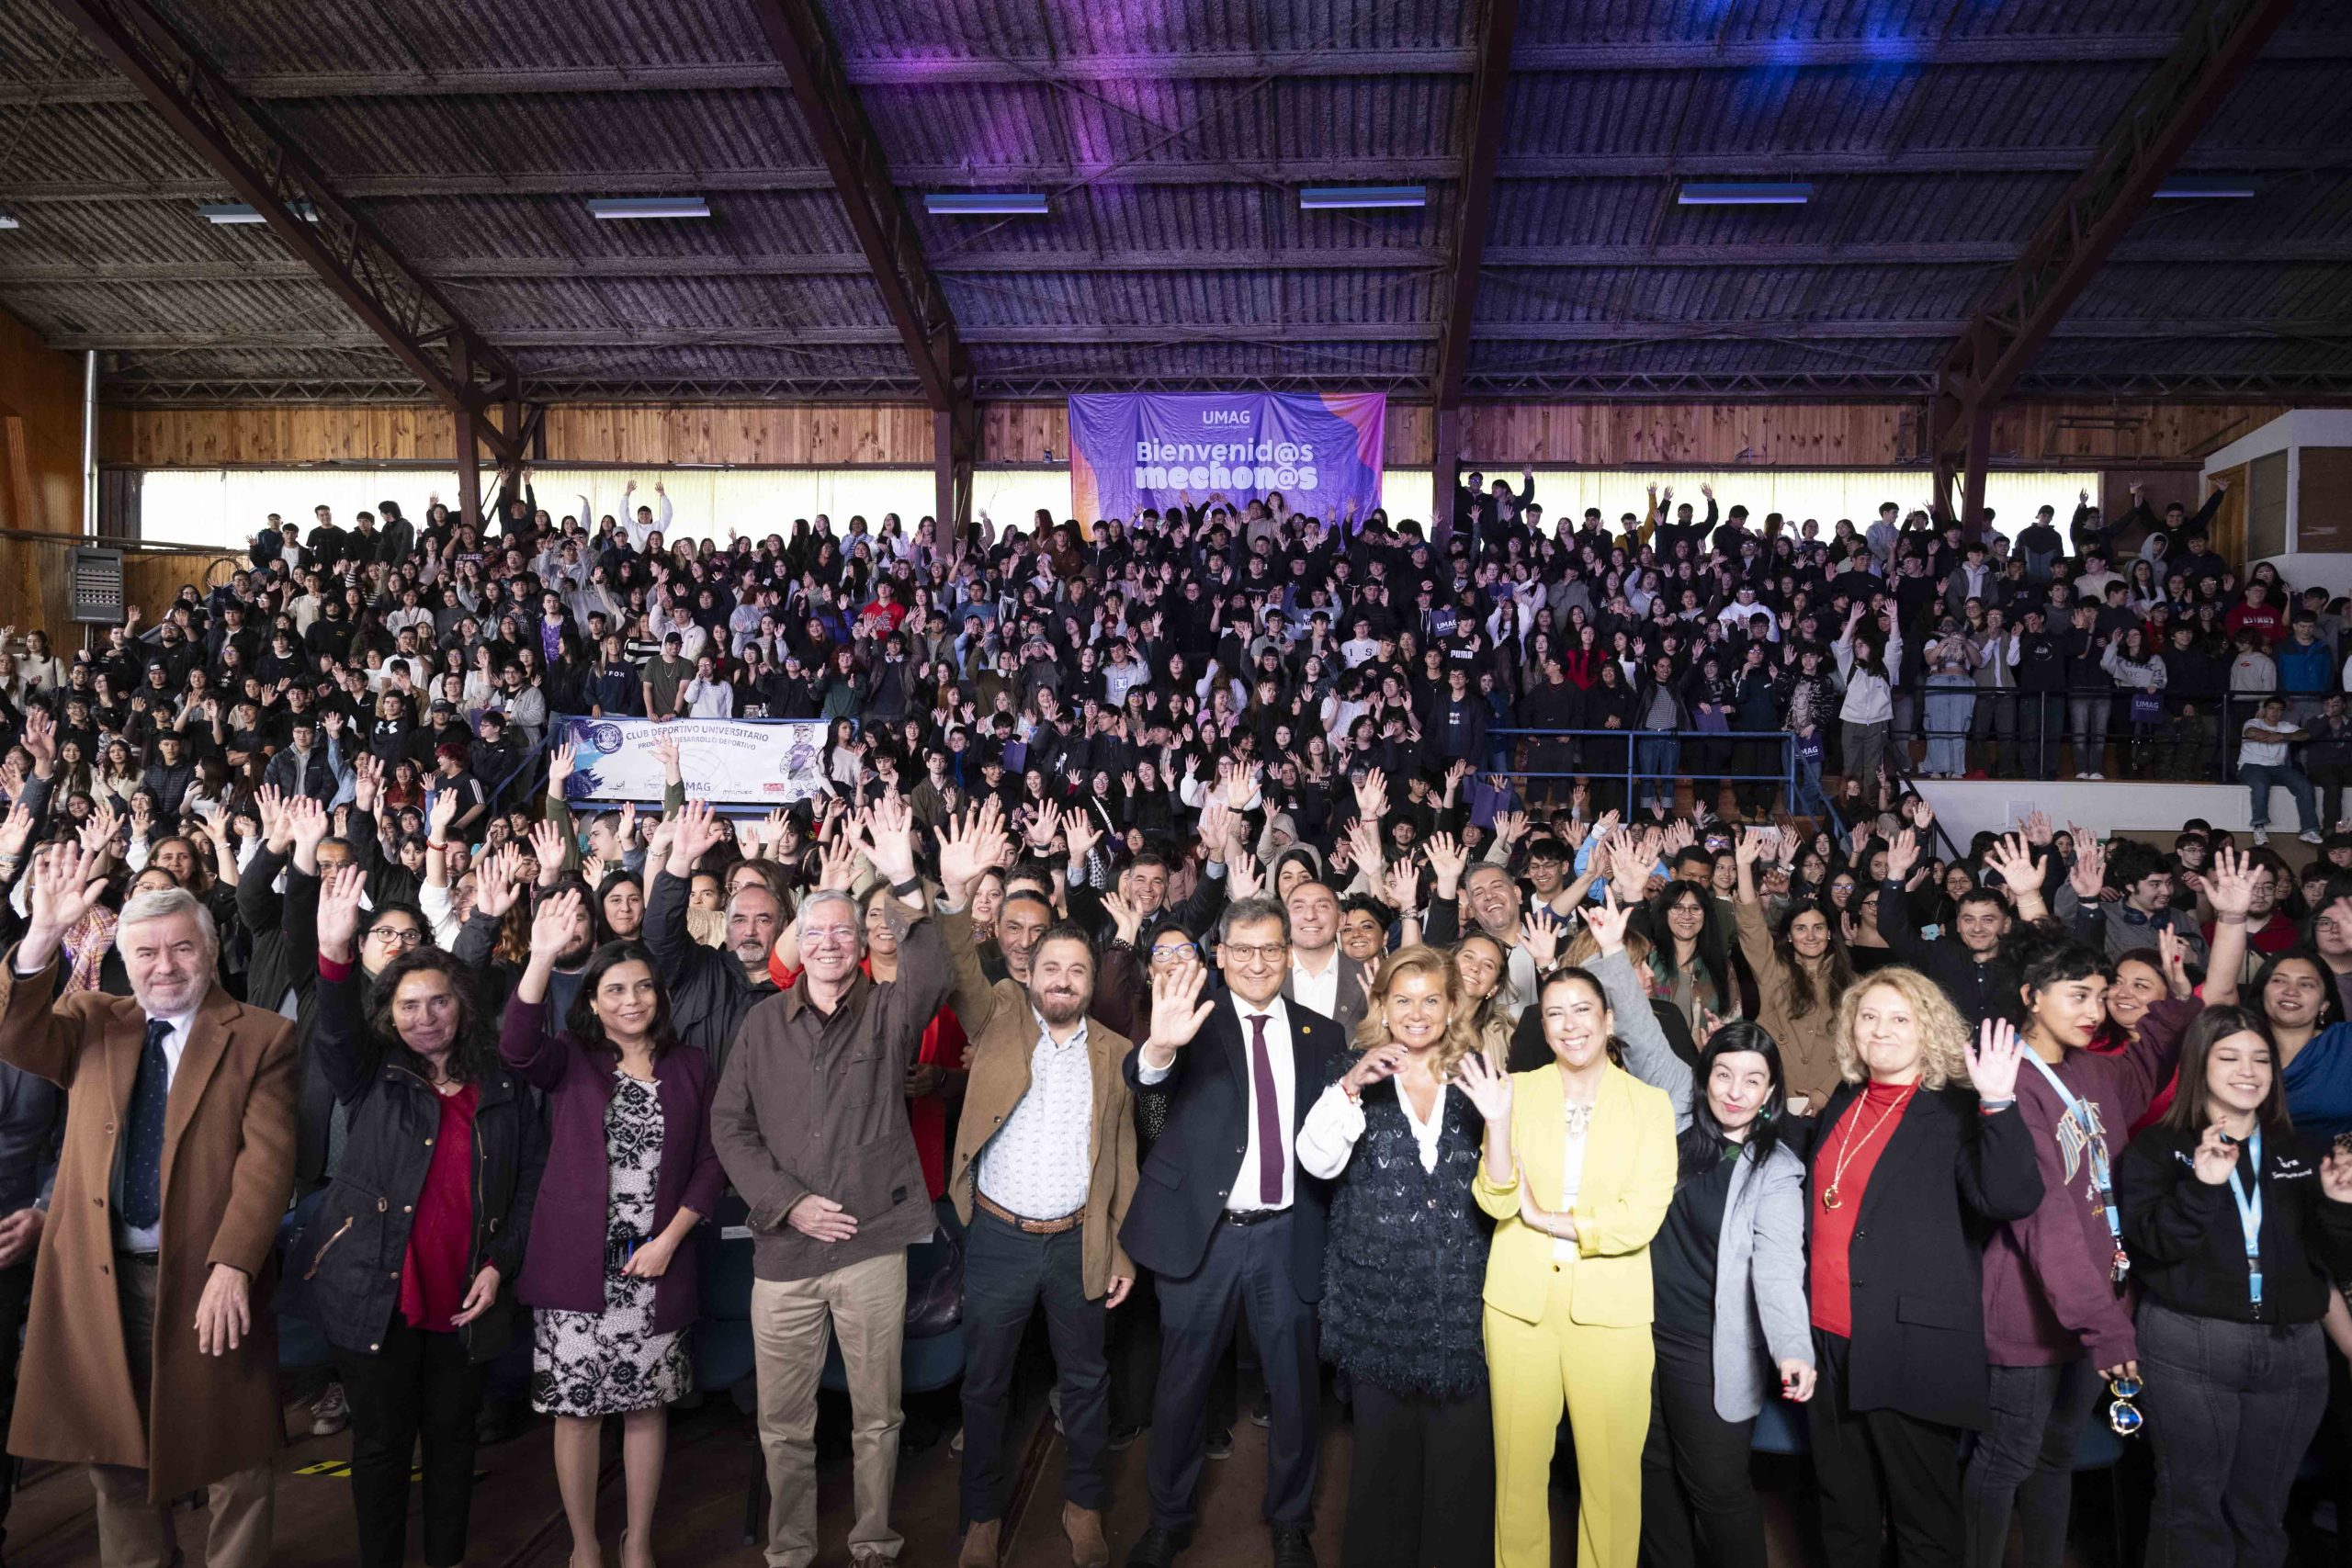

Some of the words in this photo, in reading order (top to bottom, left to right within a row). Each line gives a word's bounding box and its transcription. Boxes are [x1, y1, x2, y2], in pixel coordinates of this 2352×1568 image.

[1203, 410, 1250, 424] UMAG
[1136, 437, 1314, 467] Bienvenid@s
[1135, 461, 1318, 491] mechon@s
[1451, 649, 1473, 659] PUMA
[626, 729, 650, 740] CLUB
[650, 725, 700, 737] DEPORTIVO
[702, 724, 769, 742] UNIVERSITARIO
[718, 738, 756, 750] DEPORTIVO
[1802, 746, 1819, 754] MAG
[685, 782, 711, 792] MAG
